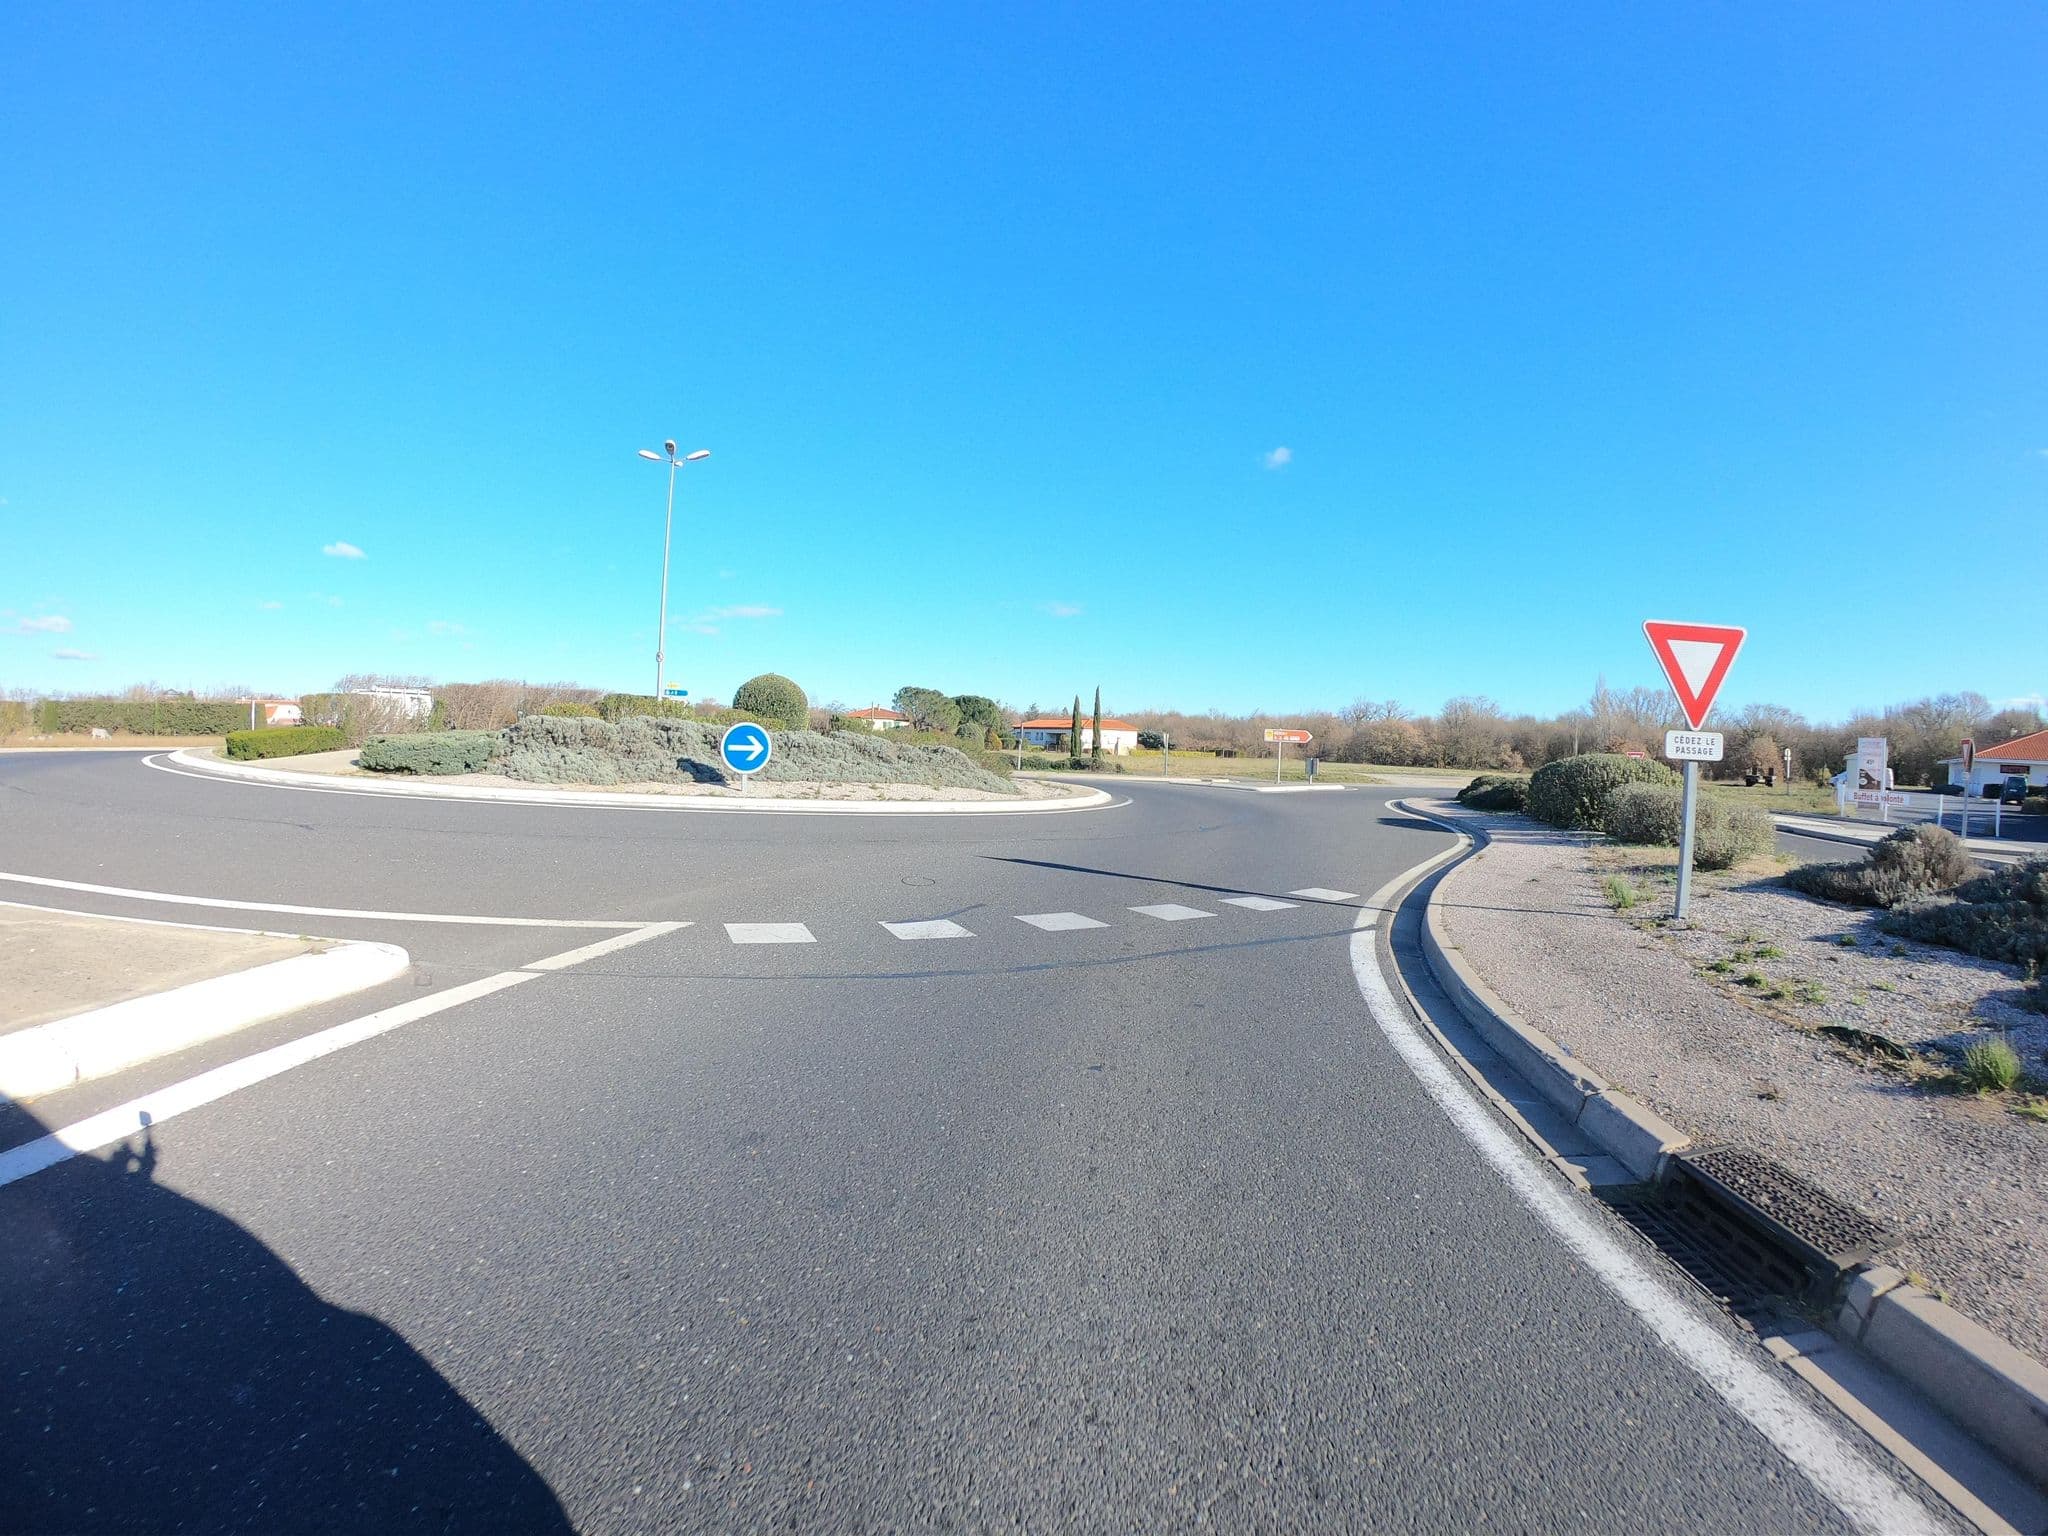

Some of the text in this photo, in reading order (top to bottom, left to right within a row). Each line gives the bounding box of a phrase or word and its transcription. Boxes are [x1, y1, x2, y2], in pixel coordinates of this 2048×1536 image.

[1674, 735, 1715, 746] CÉDEZ LE
[1675, 746, 1713, 755] PASSAGE
[1853, 792, 1873, 801] Buffet
